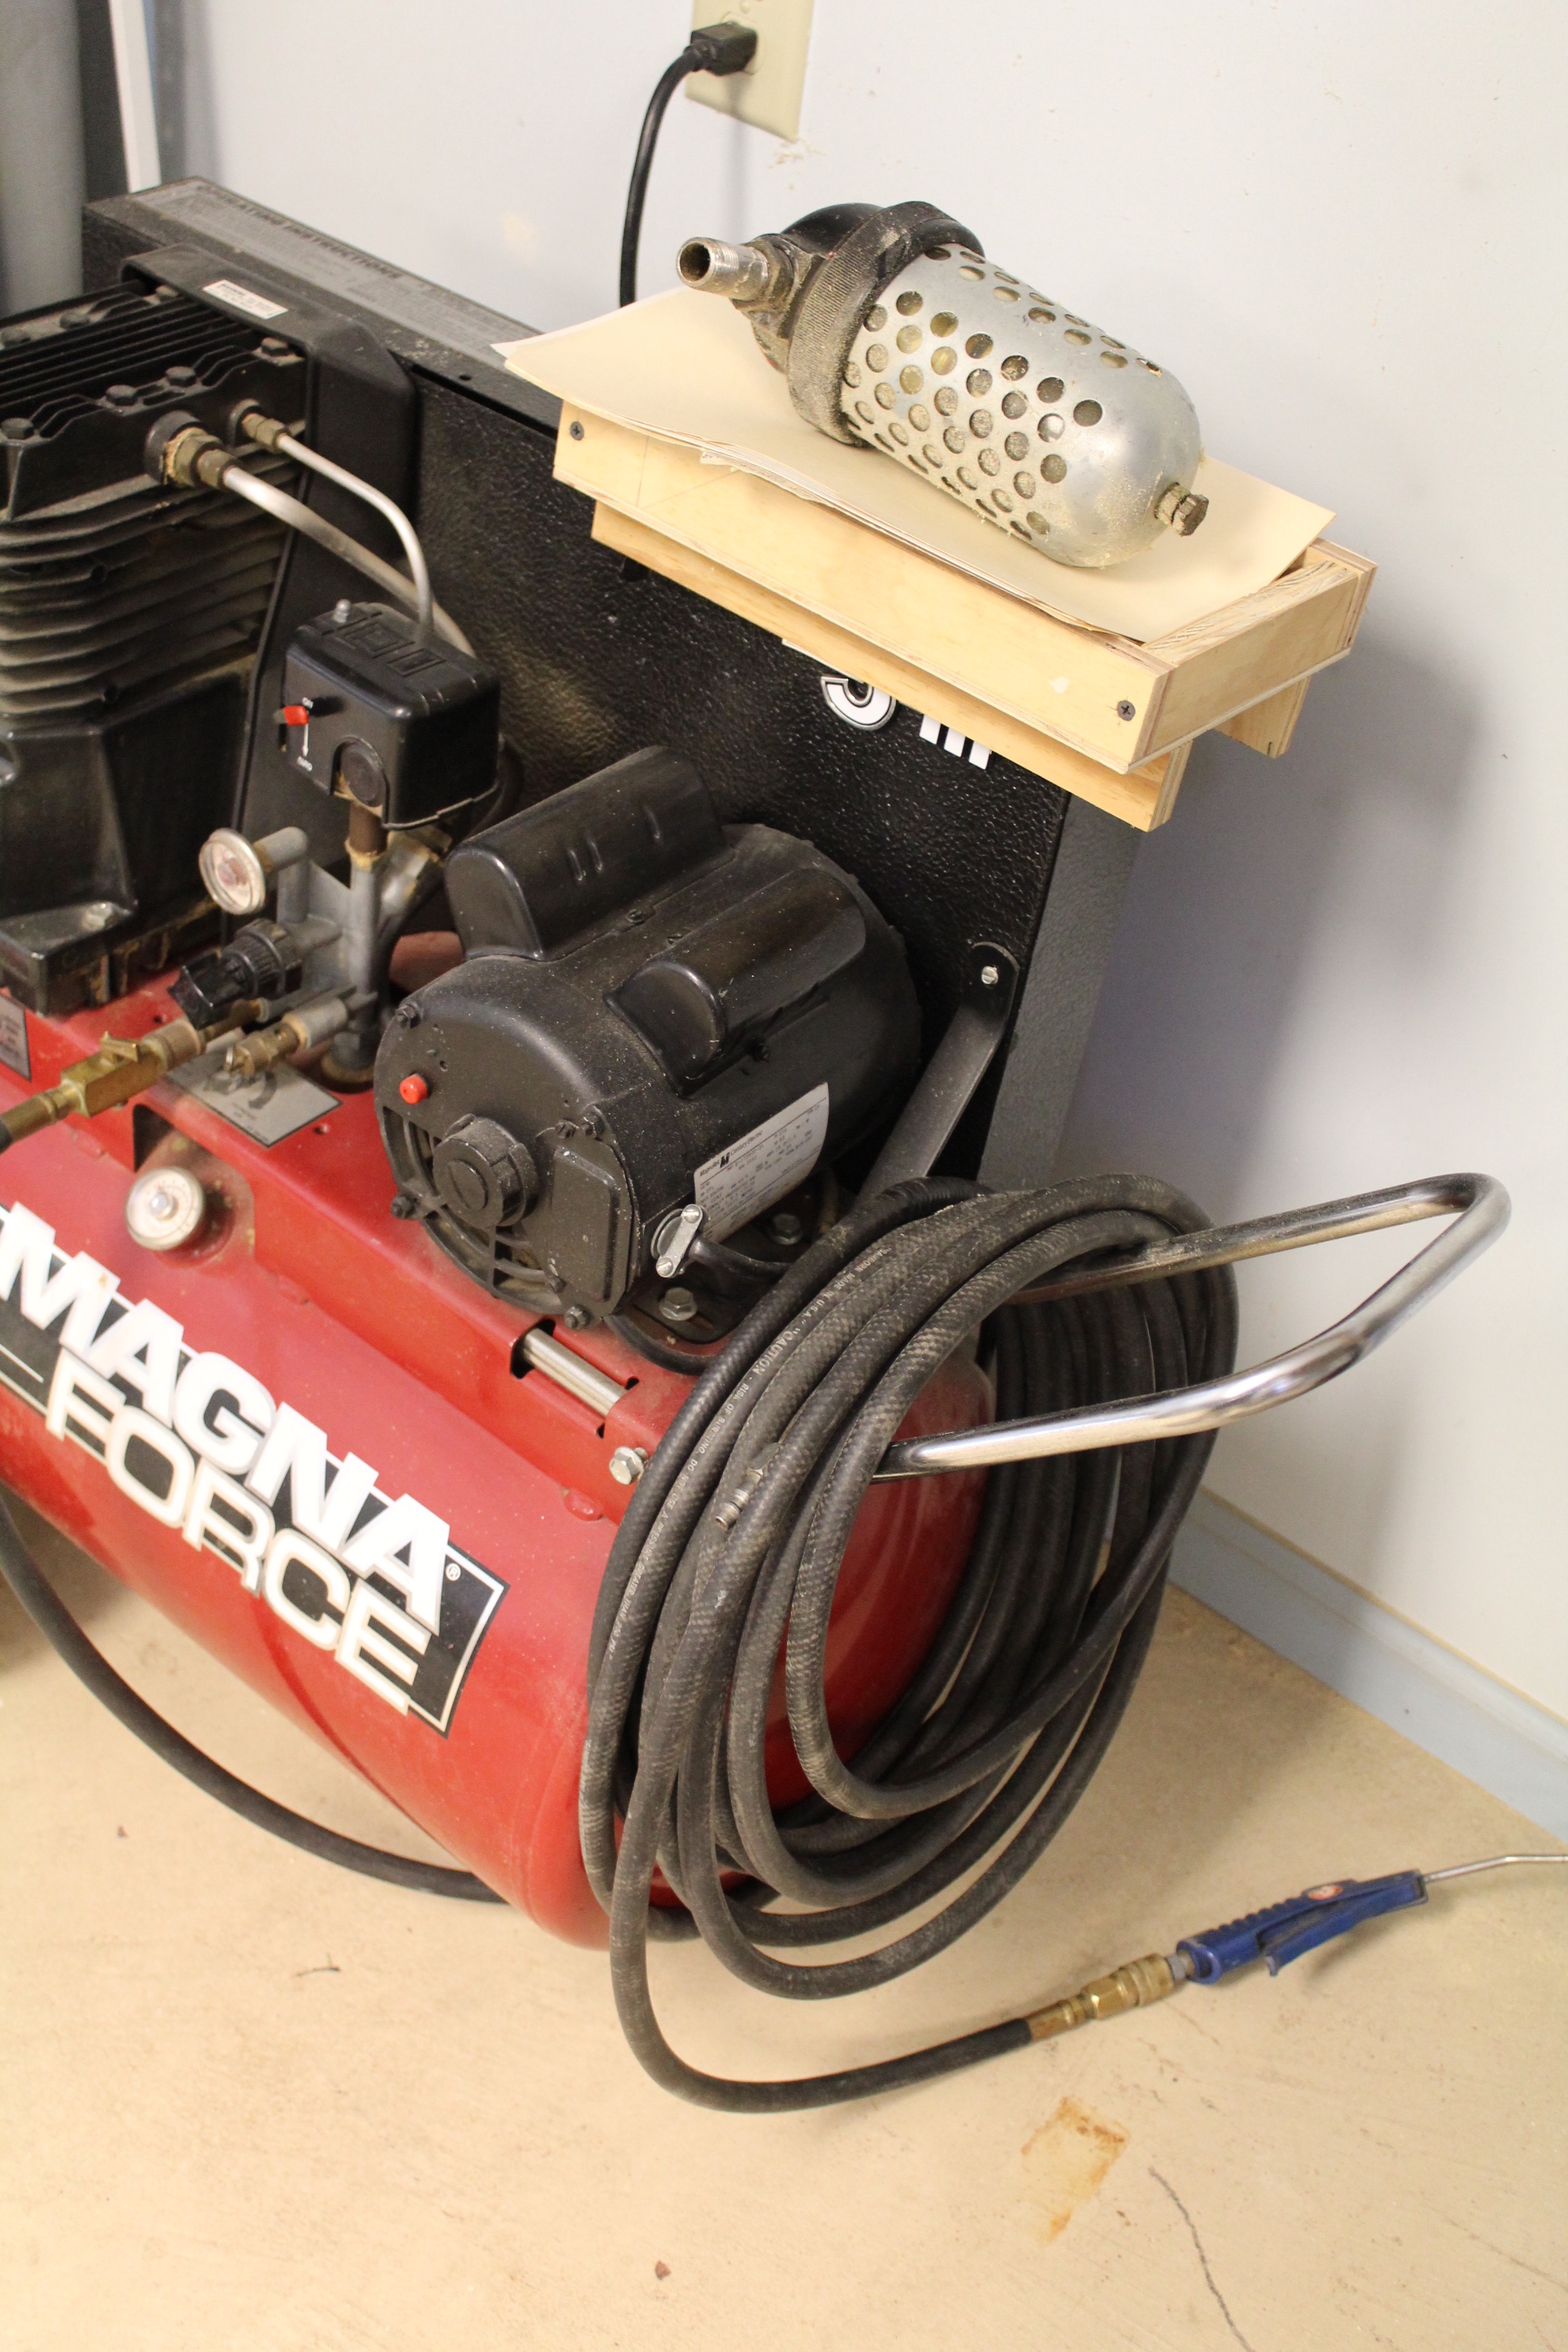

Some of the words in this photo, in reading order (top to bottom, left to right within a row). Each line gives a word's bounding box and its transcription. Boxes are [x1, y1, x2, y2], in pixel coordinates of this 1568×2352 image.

[834, 1273, 855, 1290] MADE
[733, 1382, 749, 1401] RISK
[0, 1201, 451, 1636] MAGNA
[723, 1403, 735, 1416] OF
[687, 1458, 698, 1472] DO
[46, 1345, 433, 1716] FORCE
